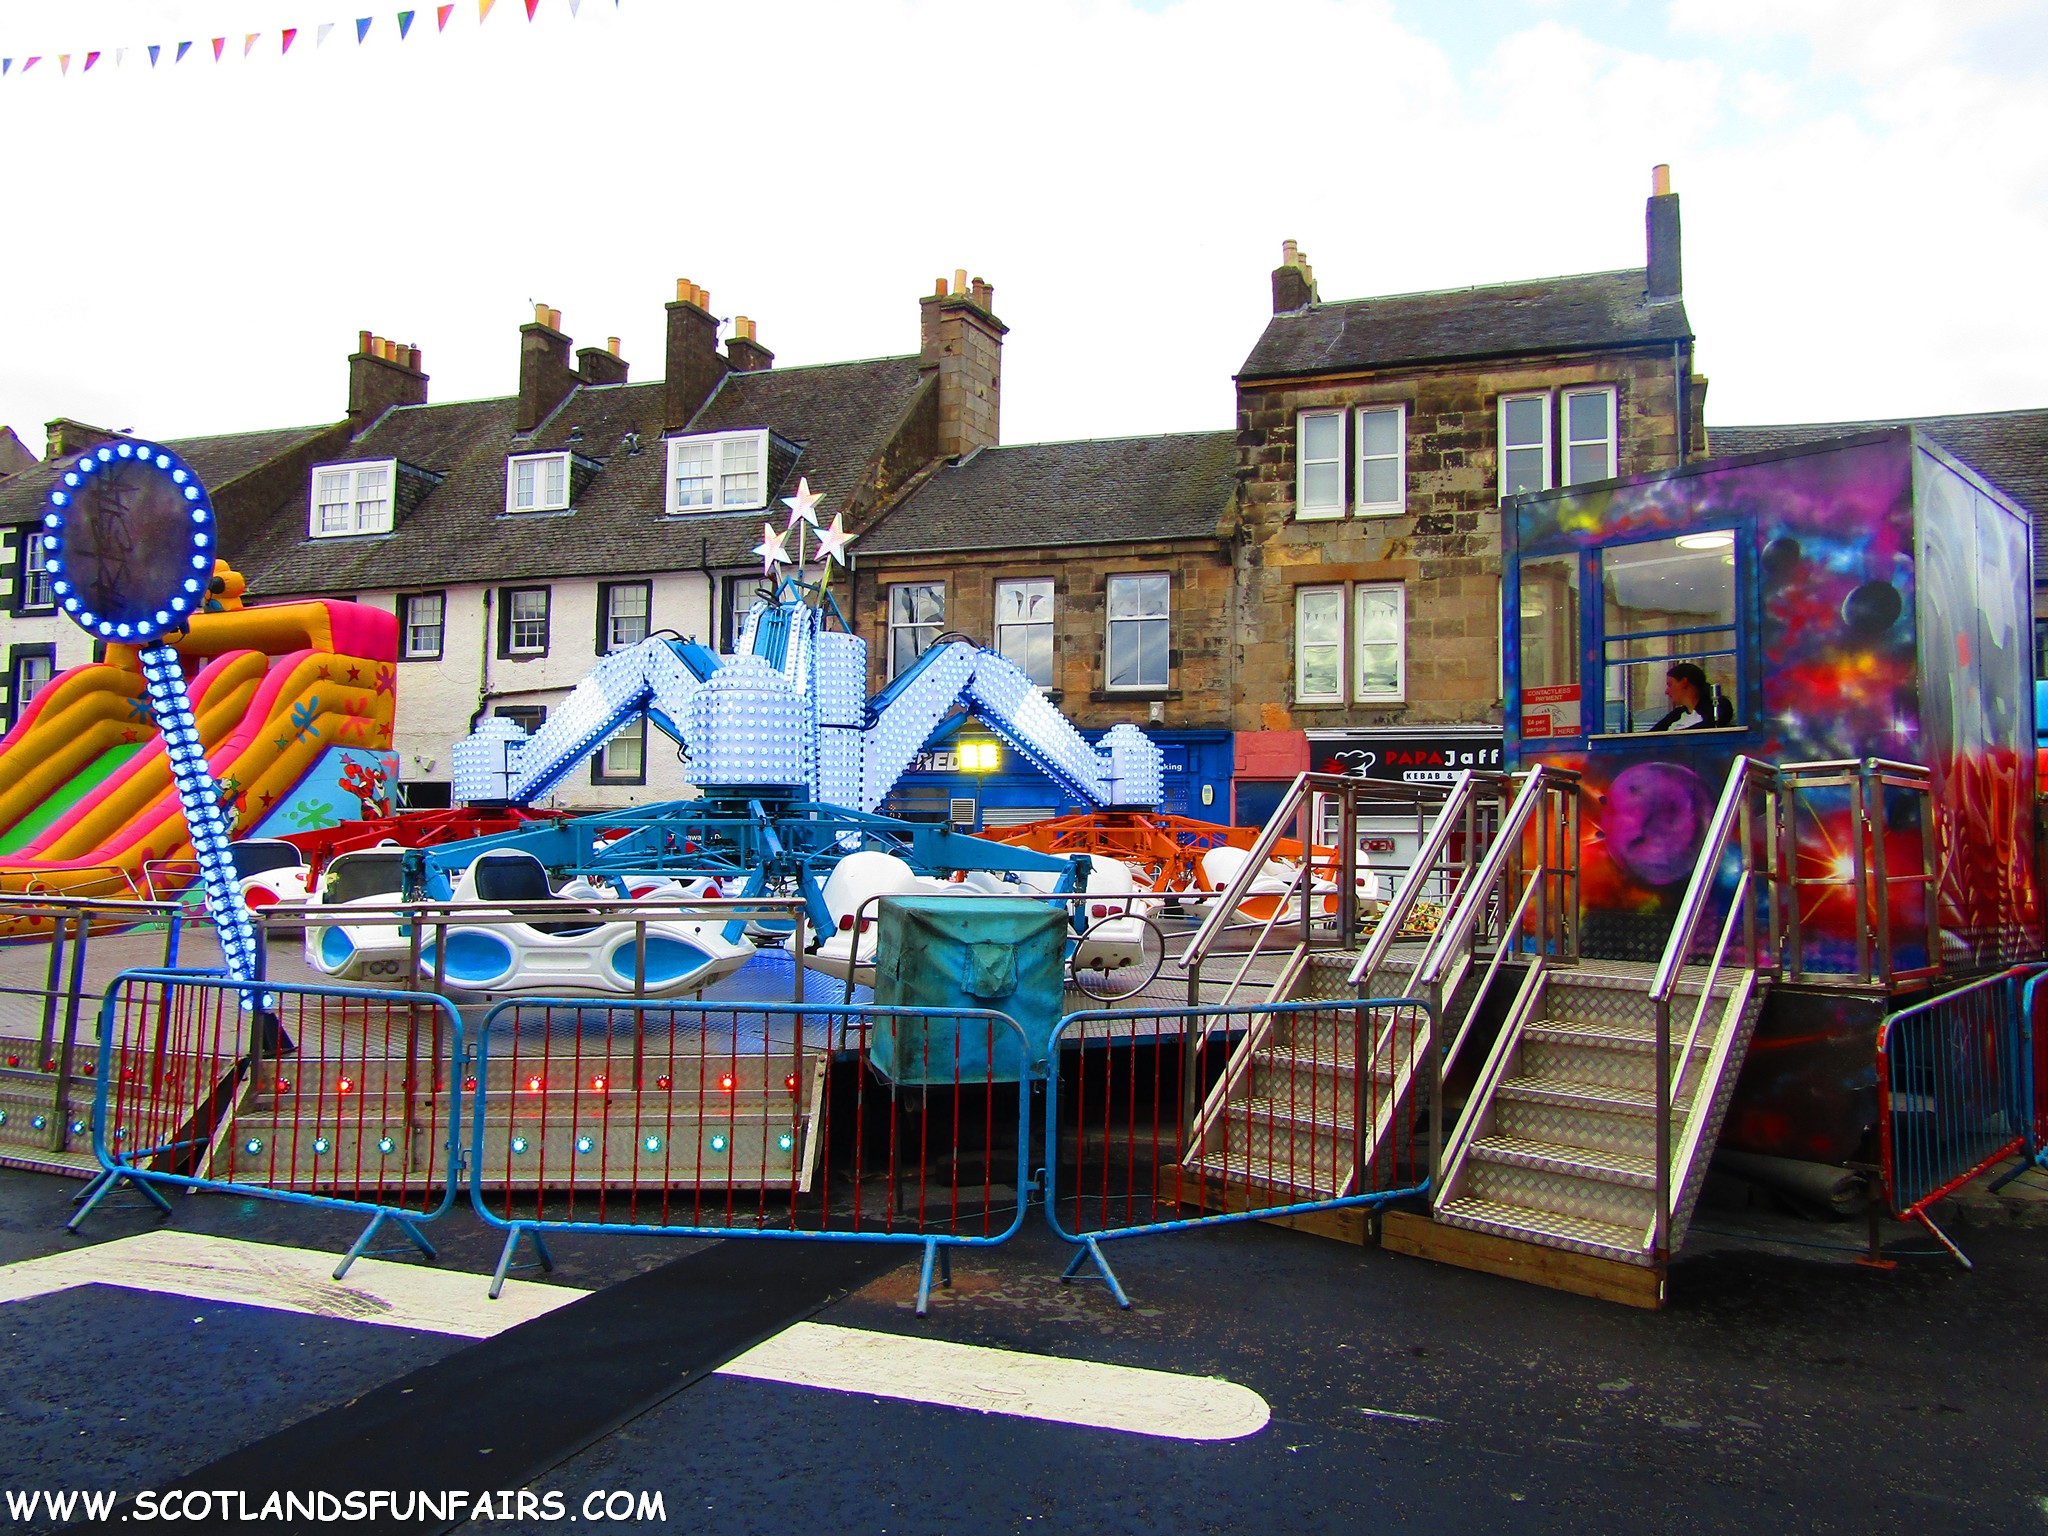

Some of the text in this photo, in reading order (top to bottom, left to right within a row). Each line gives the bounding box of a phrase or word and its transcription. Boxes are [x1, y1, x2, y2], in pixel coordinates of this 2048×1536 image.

[1527, 687, 1571, 697] CONTACTLESS
[1535, 694, 1563, 702] PAYMENT
[915, 752, 960, 771] RED
[1163, 763, 1182, 771] king
[1406, 772, 1453, 780] KEBAB &
[1361, 839, 1395, 851] OPEN
